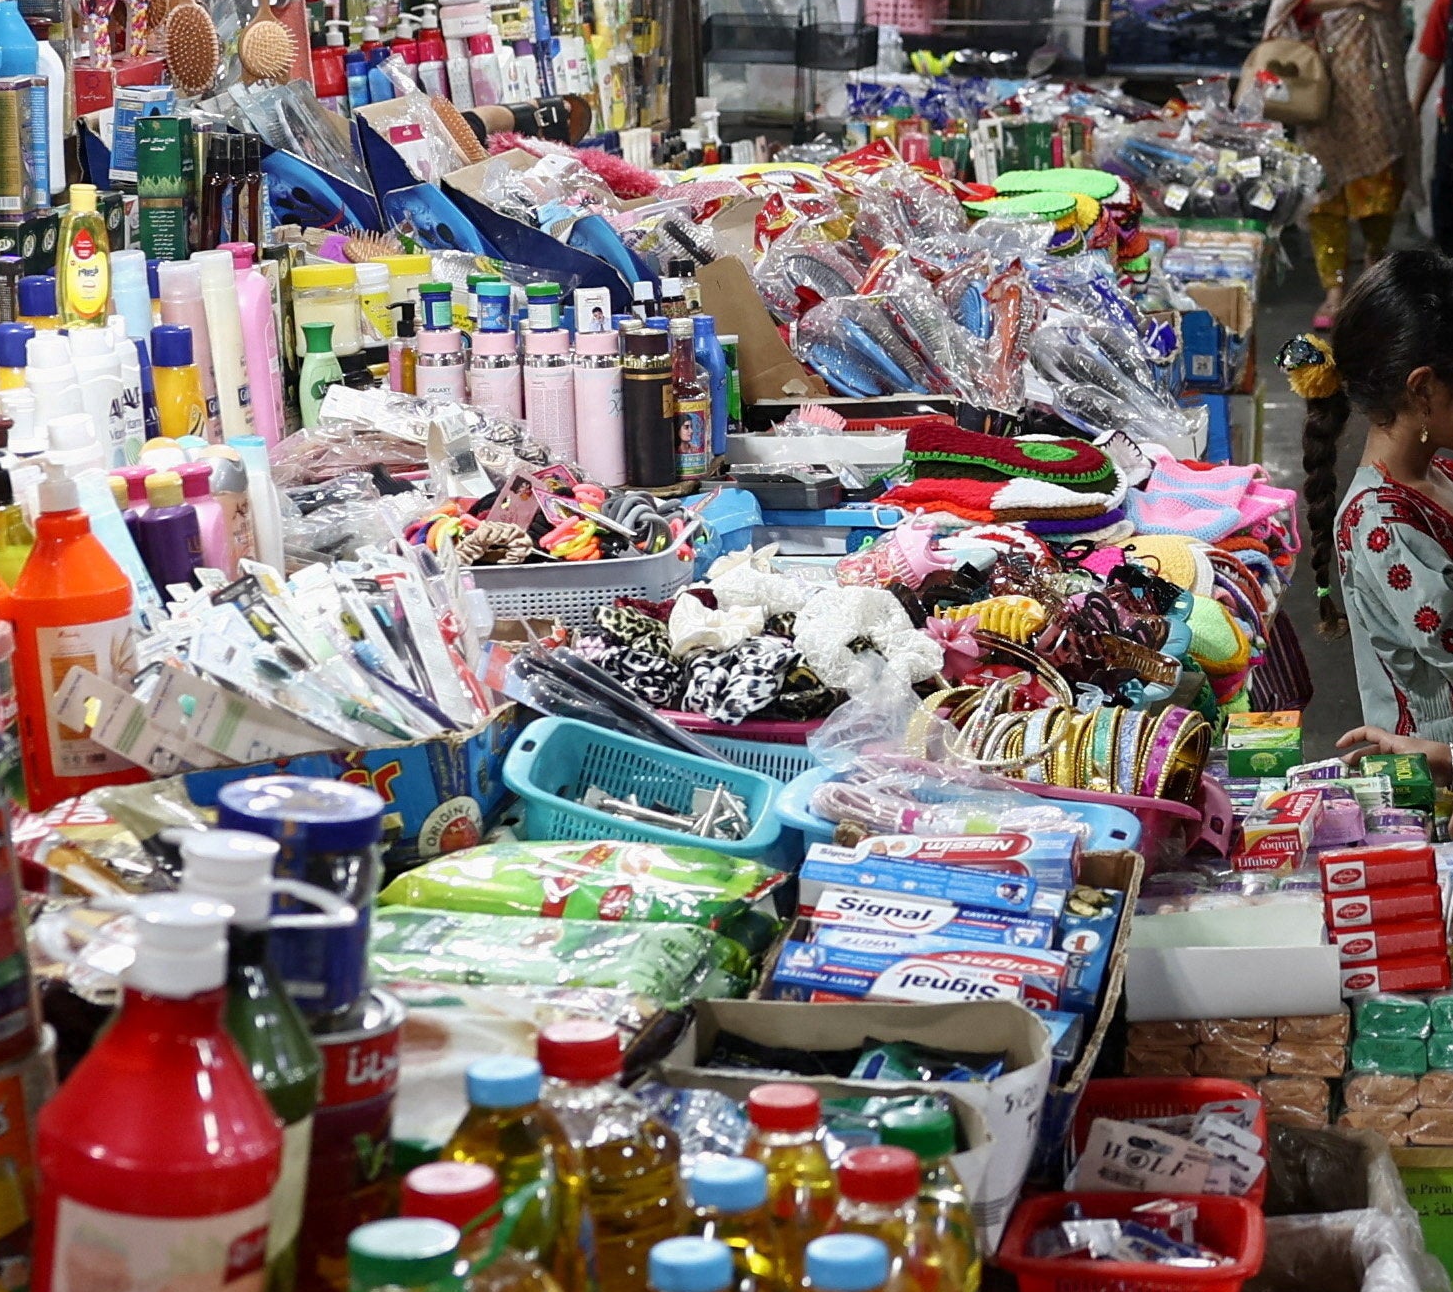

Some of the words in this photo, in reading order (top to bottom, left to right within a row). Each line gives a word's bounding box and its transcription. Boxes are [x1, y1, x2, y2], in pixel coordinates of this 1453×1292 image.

[818, 846, 858, 861] Signal
[834, 895, 934, 923] Signal
[962, 910, 998, 922] CAVITY
[941, 952, 1057, 976] Colgate
[899, 972, 1001, 1001] Signal
